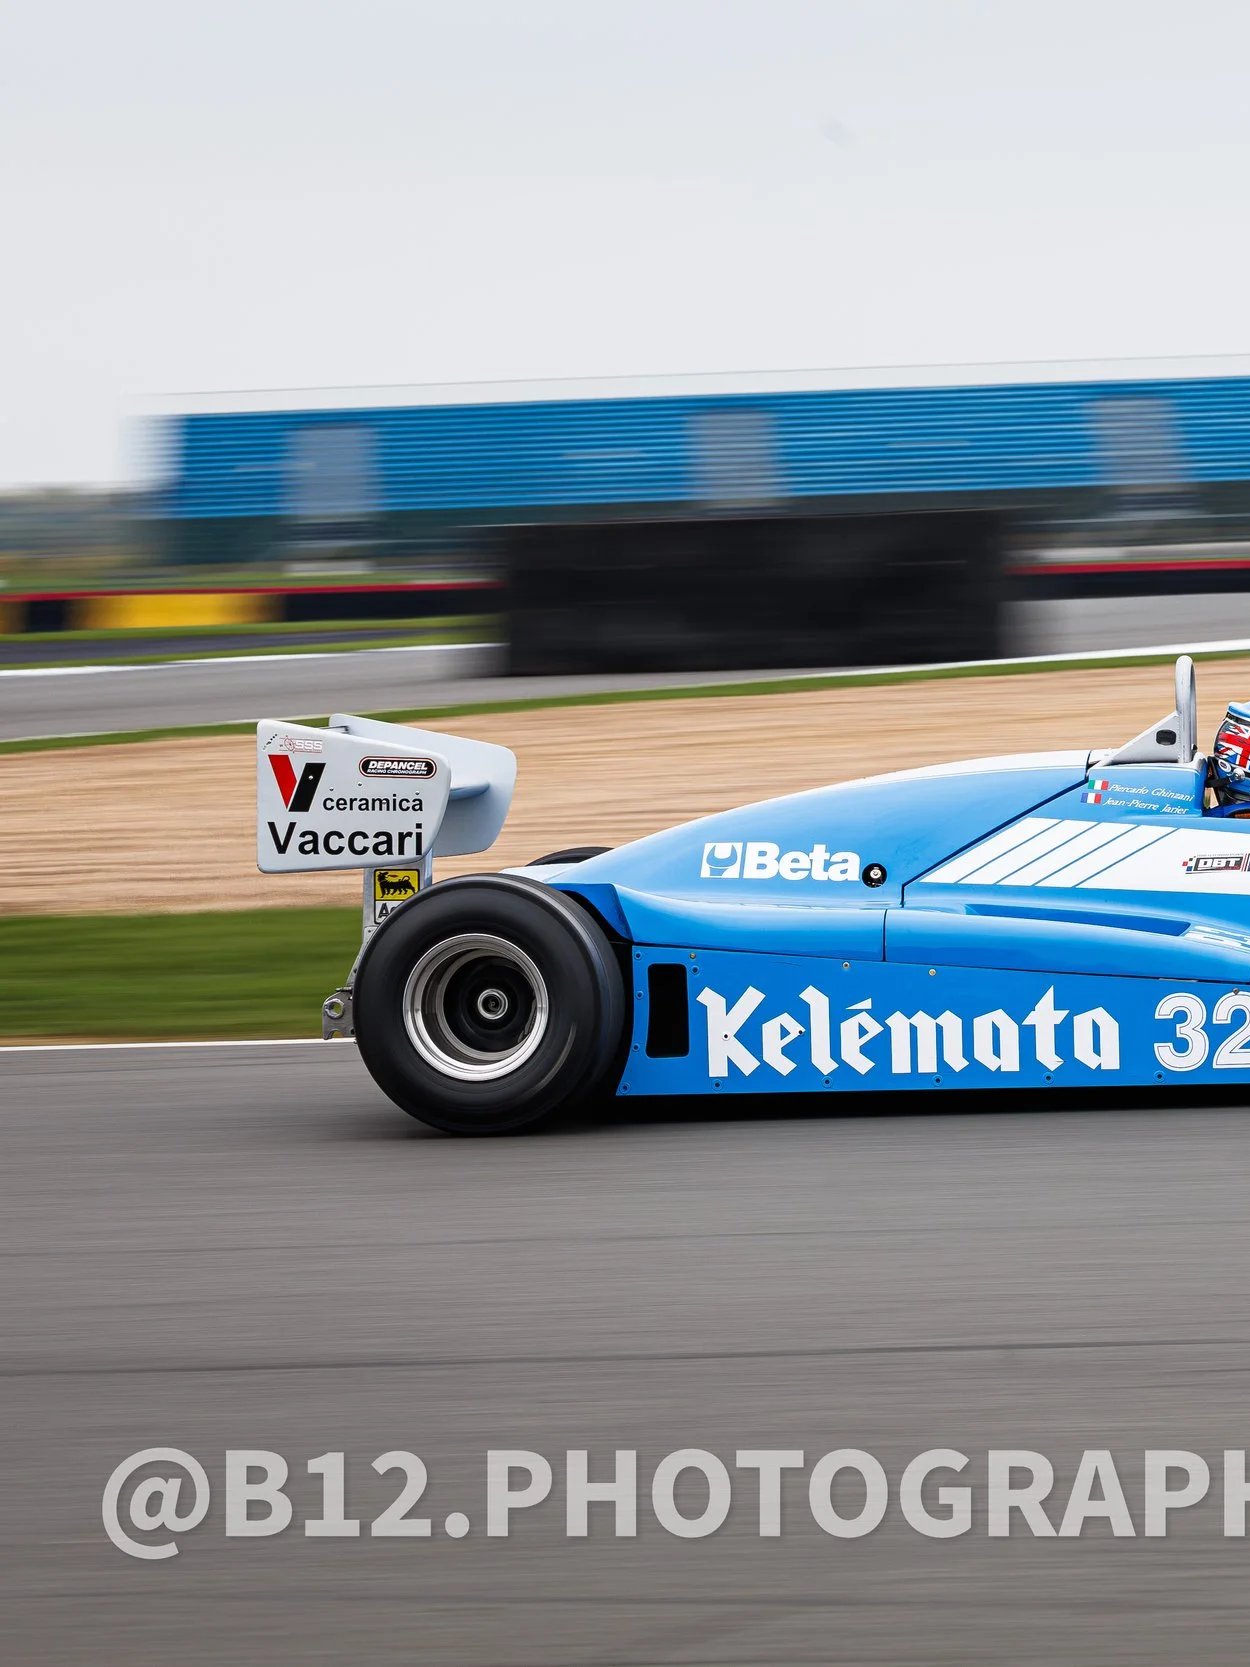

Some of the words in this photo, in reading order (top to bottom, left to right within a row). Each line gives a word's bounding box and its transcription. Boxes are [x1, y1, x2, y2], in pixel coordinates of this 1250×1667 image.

[369, 761, 428, 770] DEPANCEL
[1109, 784, 1149, 794] Piercarlo
[1152, 788, 1195, 802] Ghinzani
[323, 794, 423, 812] ceramica
[1103, 798, 1159, 810] Jean-Pierre
[1160, 804, 1189, 815] Jarier
[268, 821, 423, 856] Vaccari
[743, 842, 861, 882] Beta
[696, 984, 1120, 1077] Kelémata
